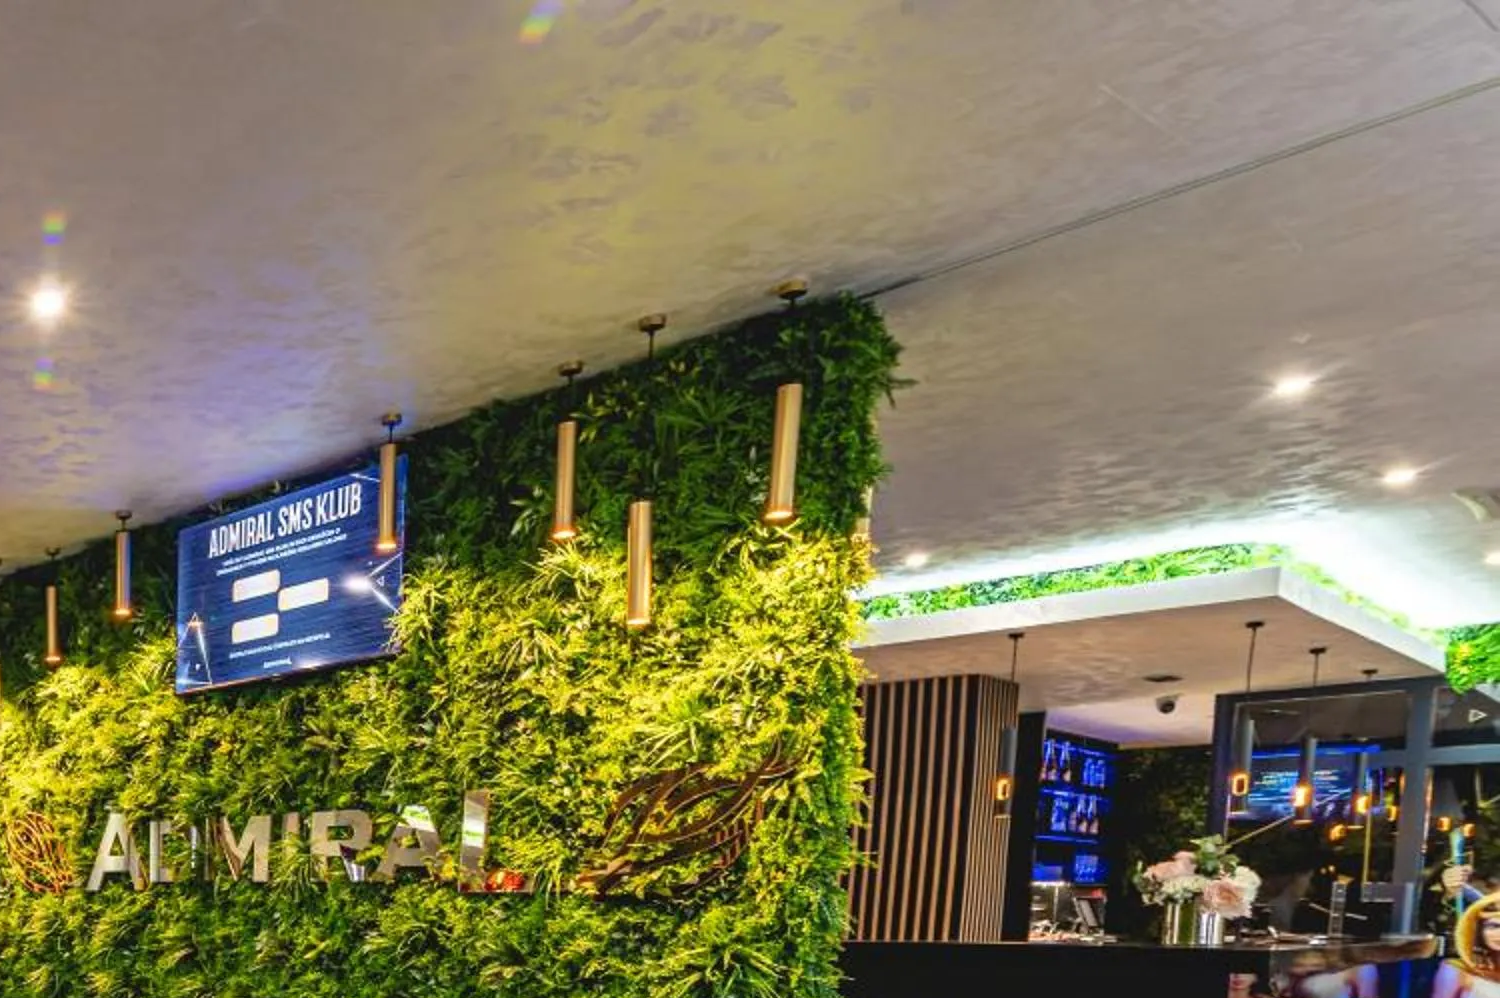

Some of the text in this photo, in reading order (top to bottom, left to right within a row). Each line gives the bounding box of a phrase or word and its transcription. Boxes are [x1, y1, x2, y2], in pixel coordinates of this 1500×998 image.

[207, 512, 275, 559] ADMIRAL
[277, 497, 314, 537] SMS
[315, 482, 362, 527] KLUB
